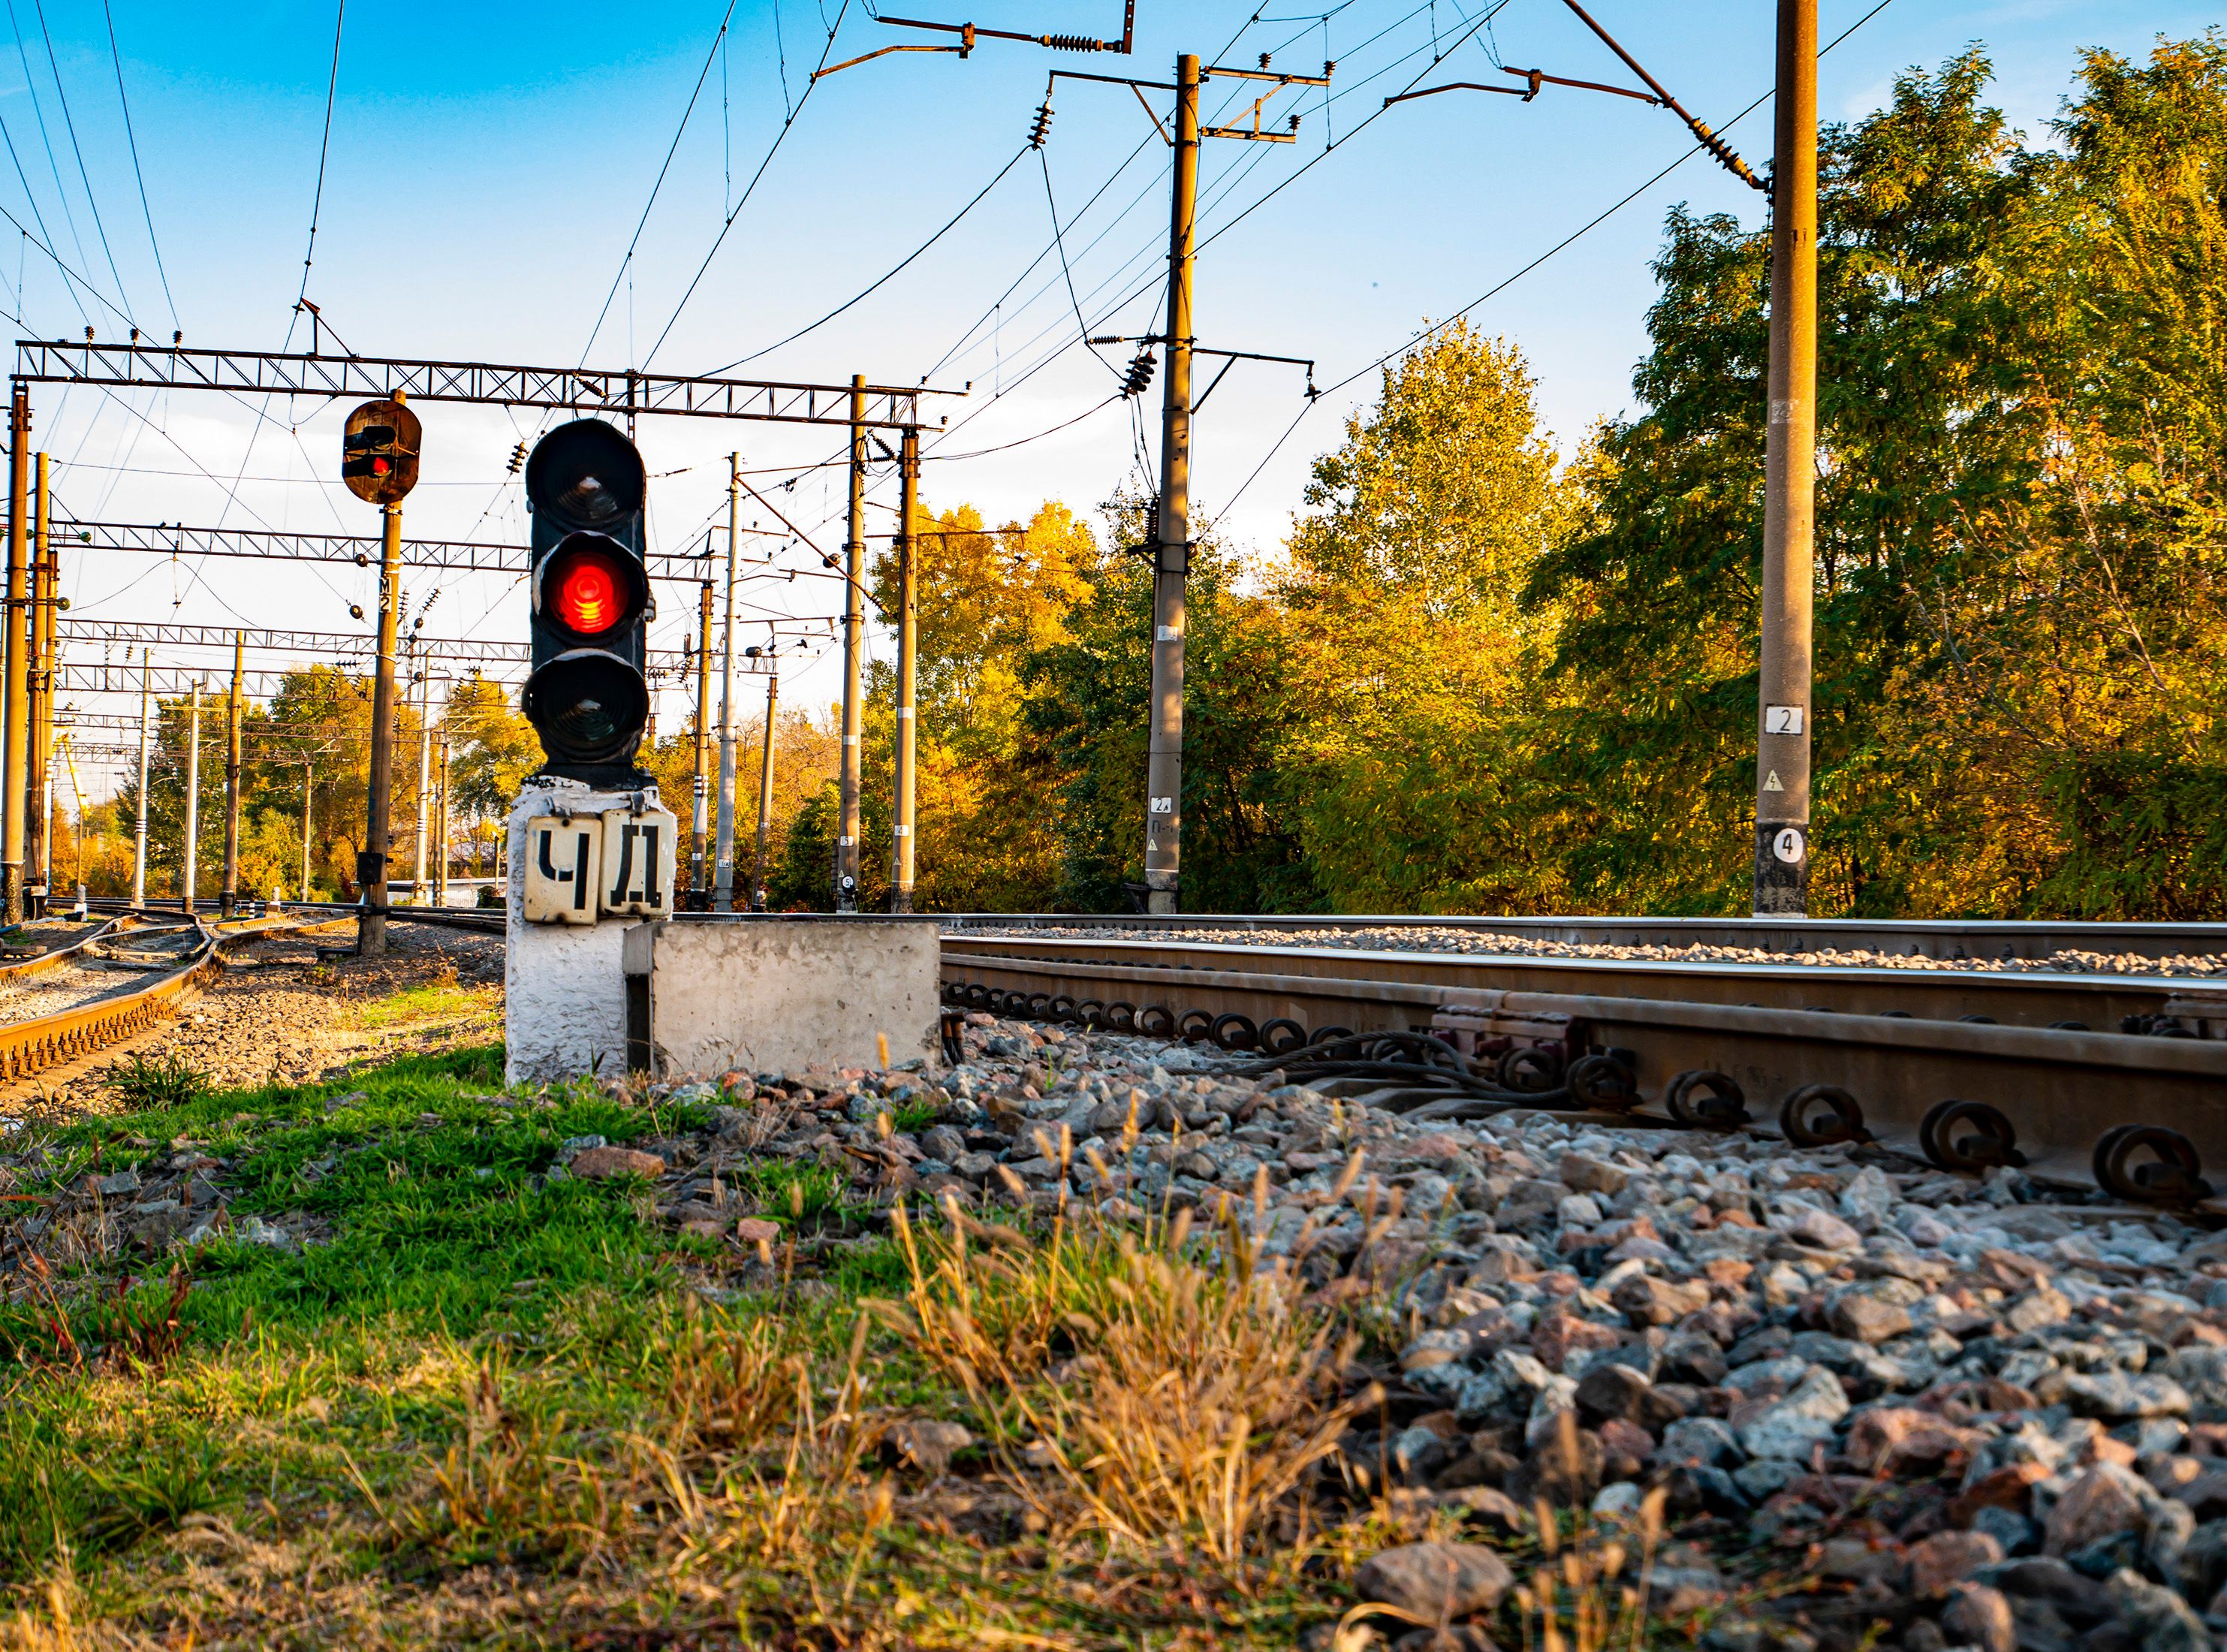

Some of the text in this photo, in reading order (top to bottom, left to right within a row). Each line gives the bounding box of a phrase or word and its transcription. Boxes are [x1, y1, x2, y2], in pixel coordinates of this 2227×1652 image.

[1780, 709, 1791, 731] 2
[844, 836, 848, 846] 5
[1783, 834, 1793, 855] 4
[538, 824, 662, 910] ЧД
[845, 878, 850, 886] 5
